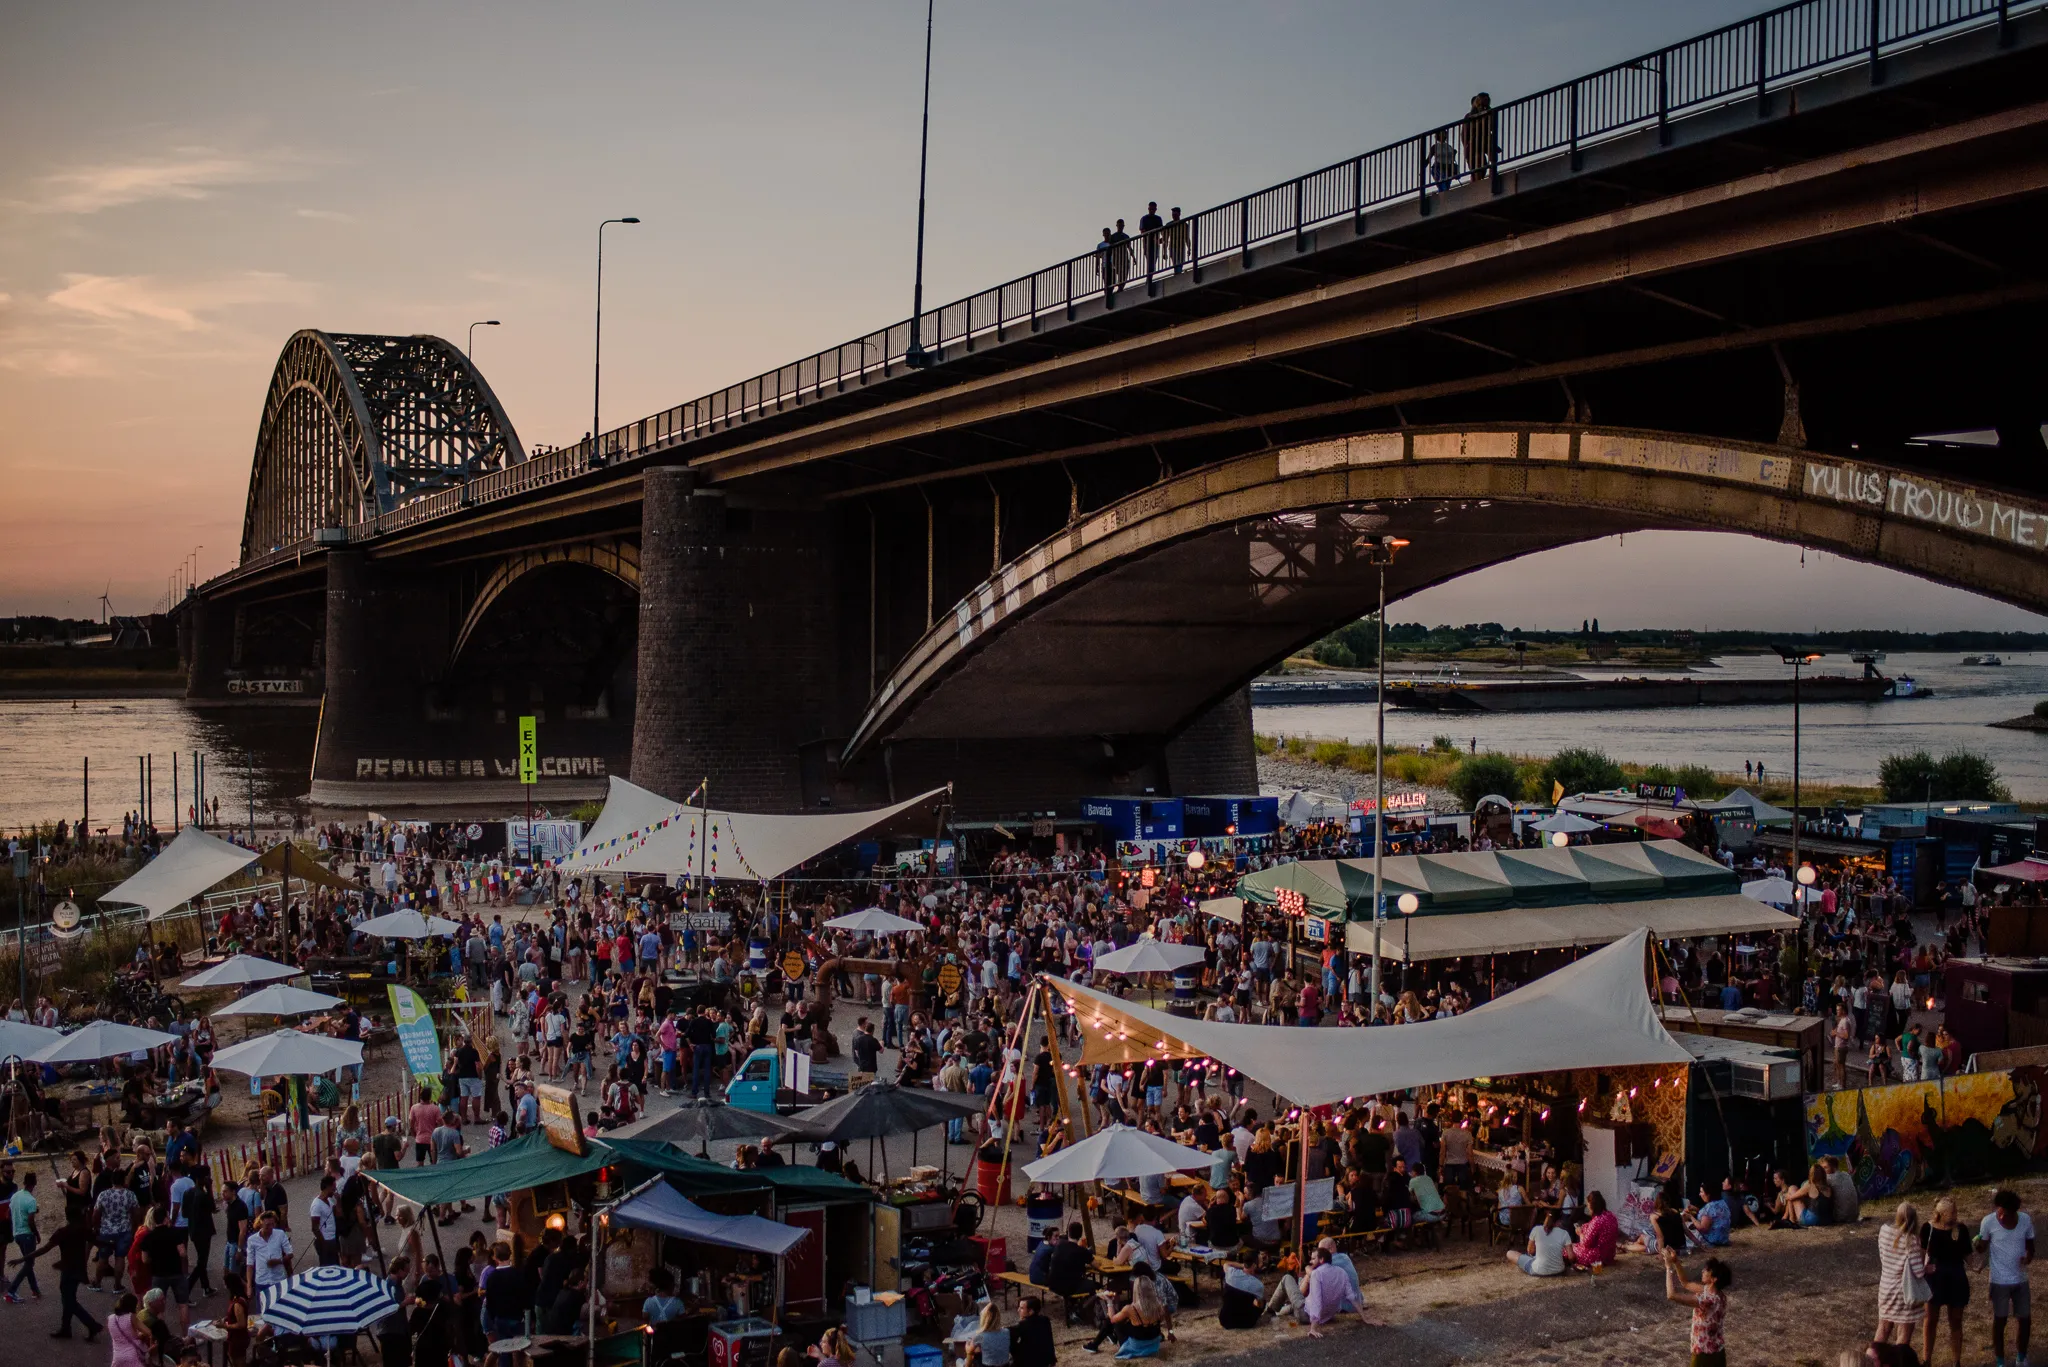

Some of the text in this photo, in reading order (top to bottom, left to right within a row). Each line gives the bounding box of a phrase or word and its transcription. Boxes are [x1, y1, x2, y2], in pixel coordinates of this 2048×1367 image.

[523, 730, 533, 781] EXIT
[1087, 803, 1113, 817] Bavaria
[1185, 803, 1211, 817] Bavaria
[1133, 805, 1142, 841] Bavaria
